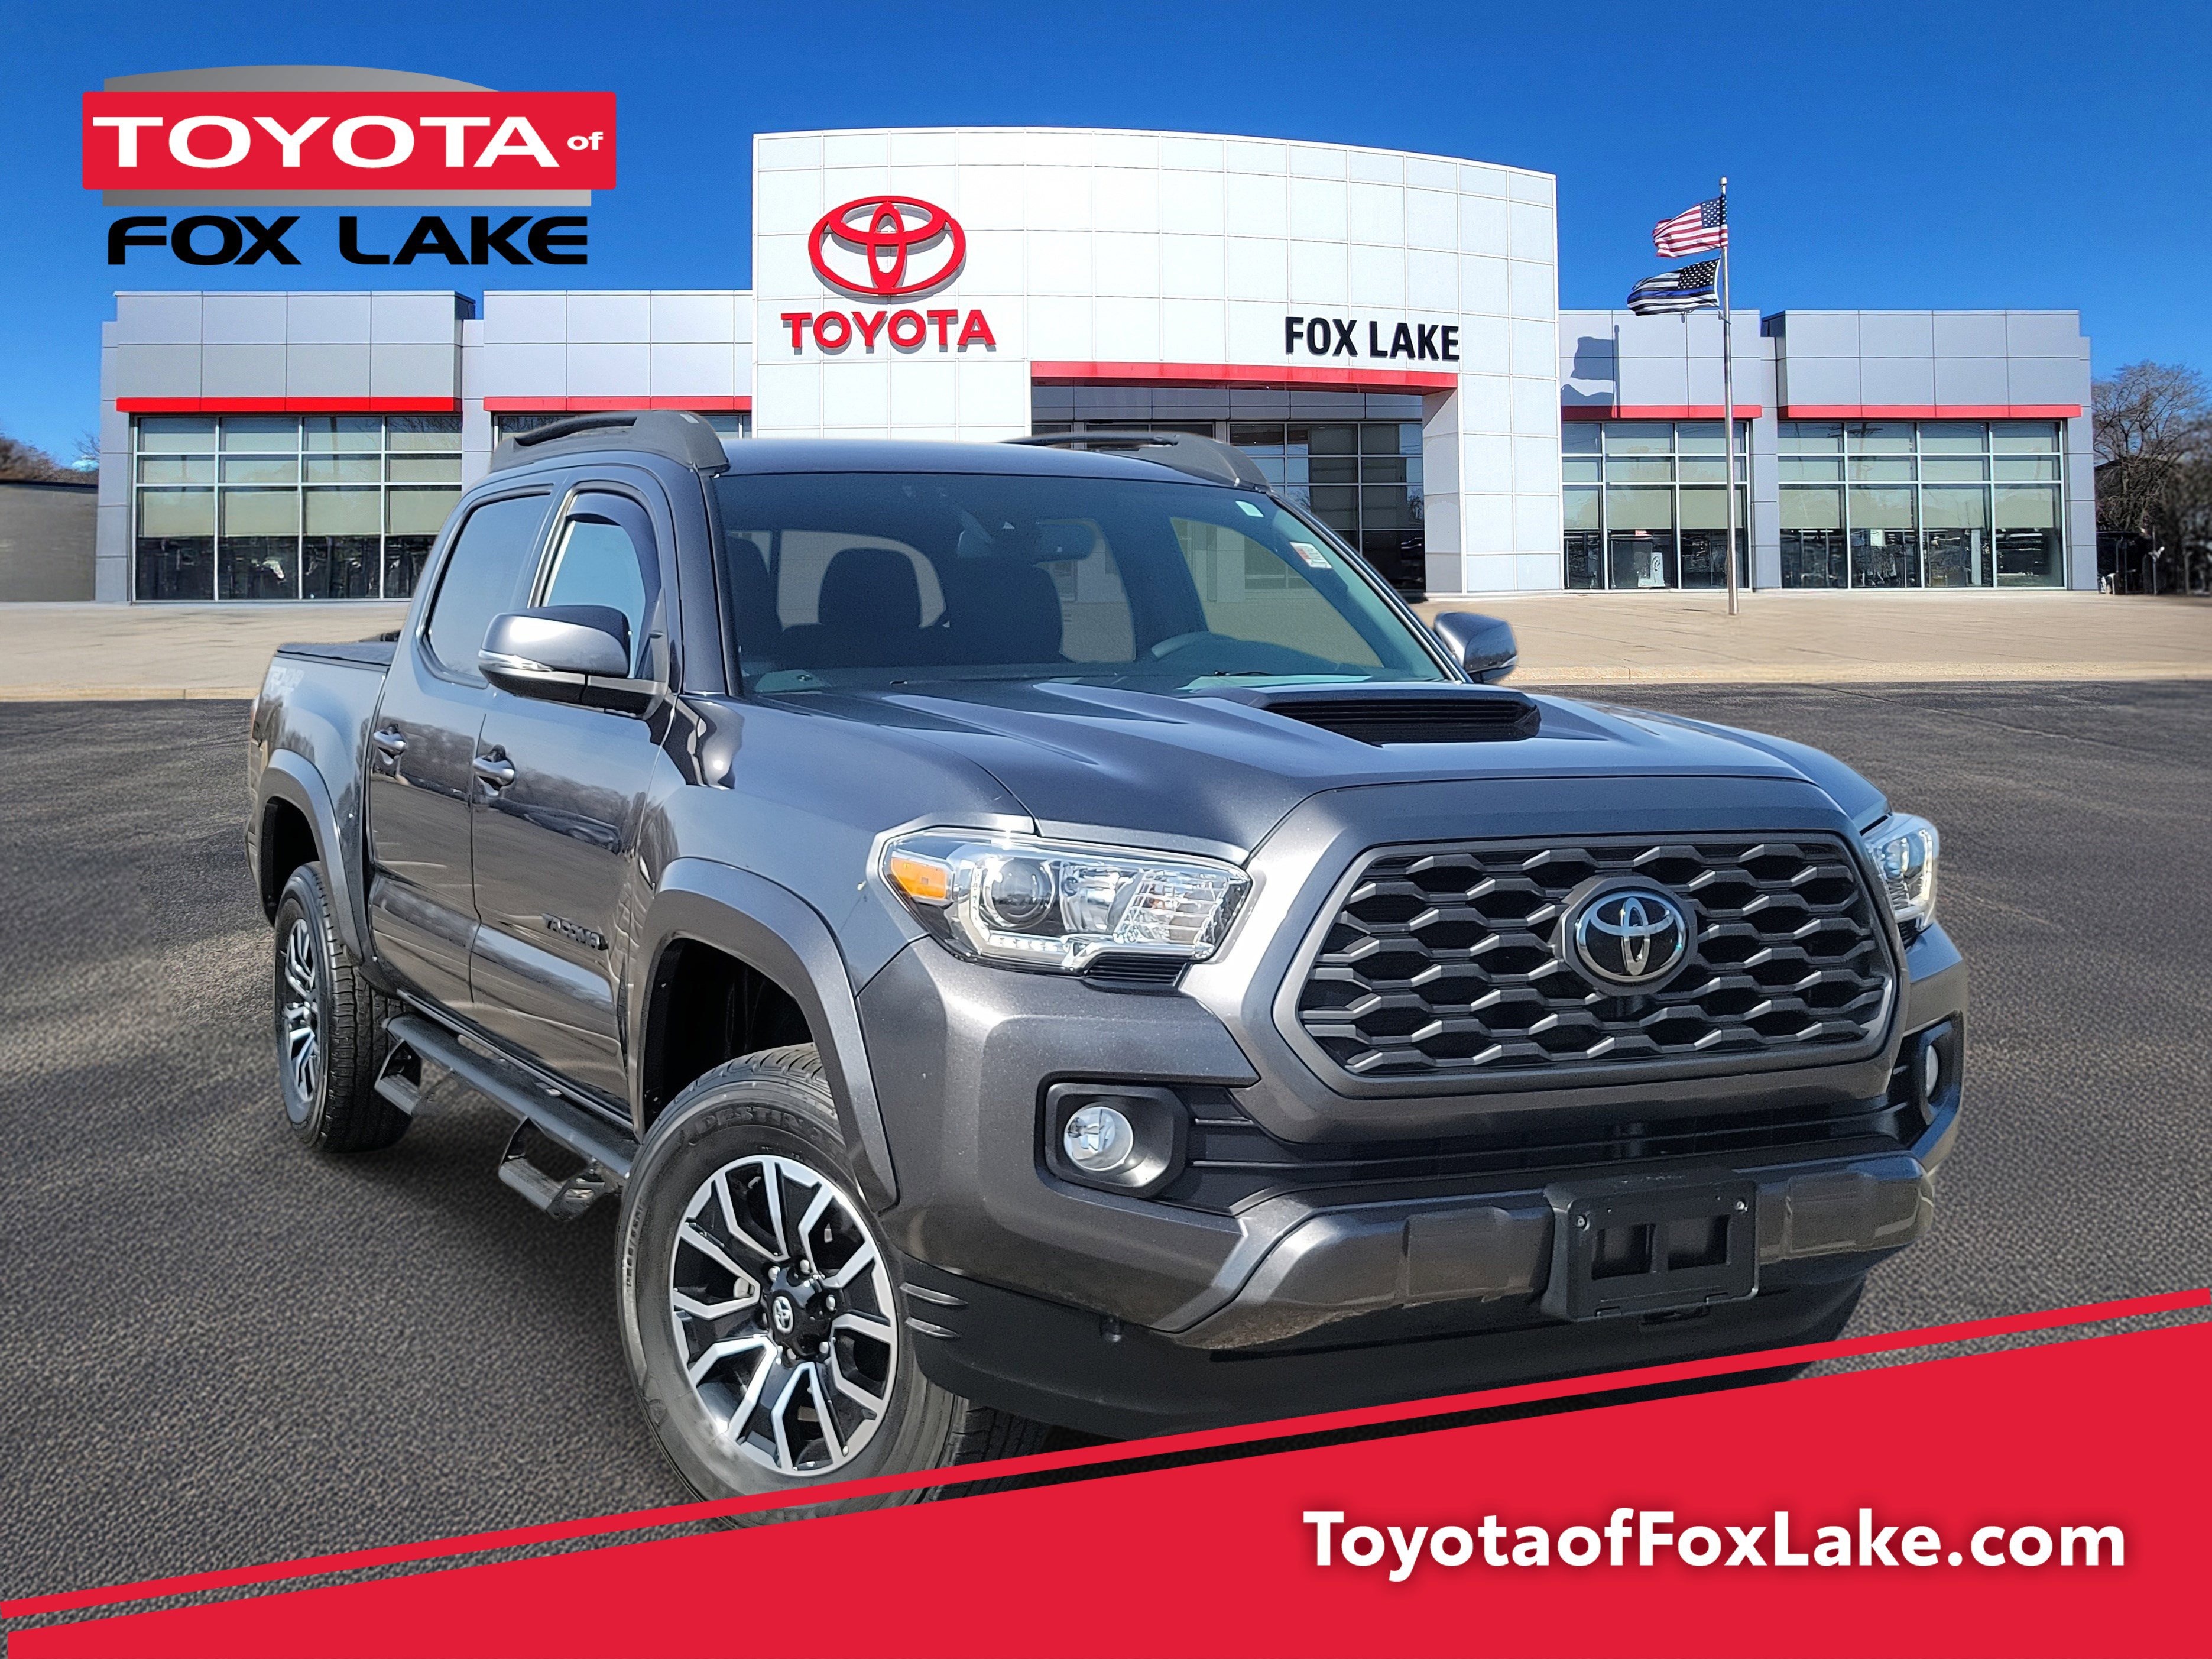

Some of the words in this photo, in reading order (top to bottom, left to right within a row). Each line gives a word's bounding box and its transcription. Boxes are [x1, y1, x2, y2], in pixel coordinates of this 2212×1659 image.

[780, 309, 997, 349] TOYOTA
[1285, 316, 1358, 356] FOX
[1370, 320, 1460, 361] LAKE
